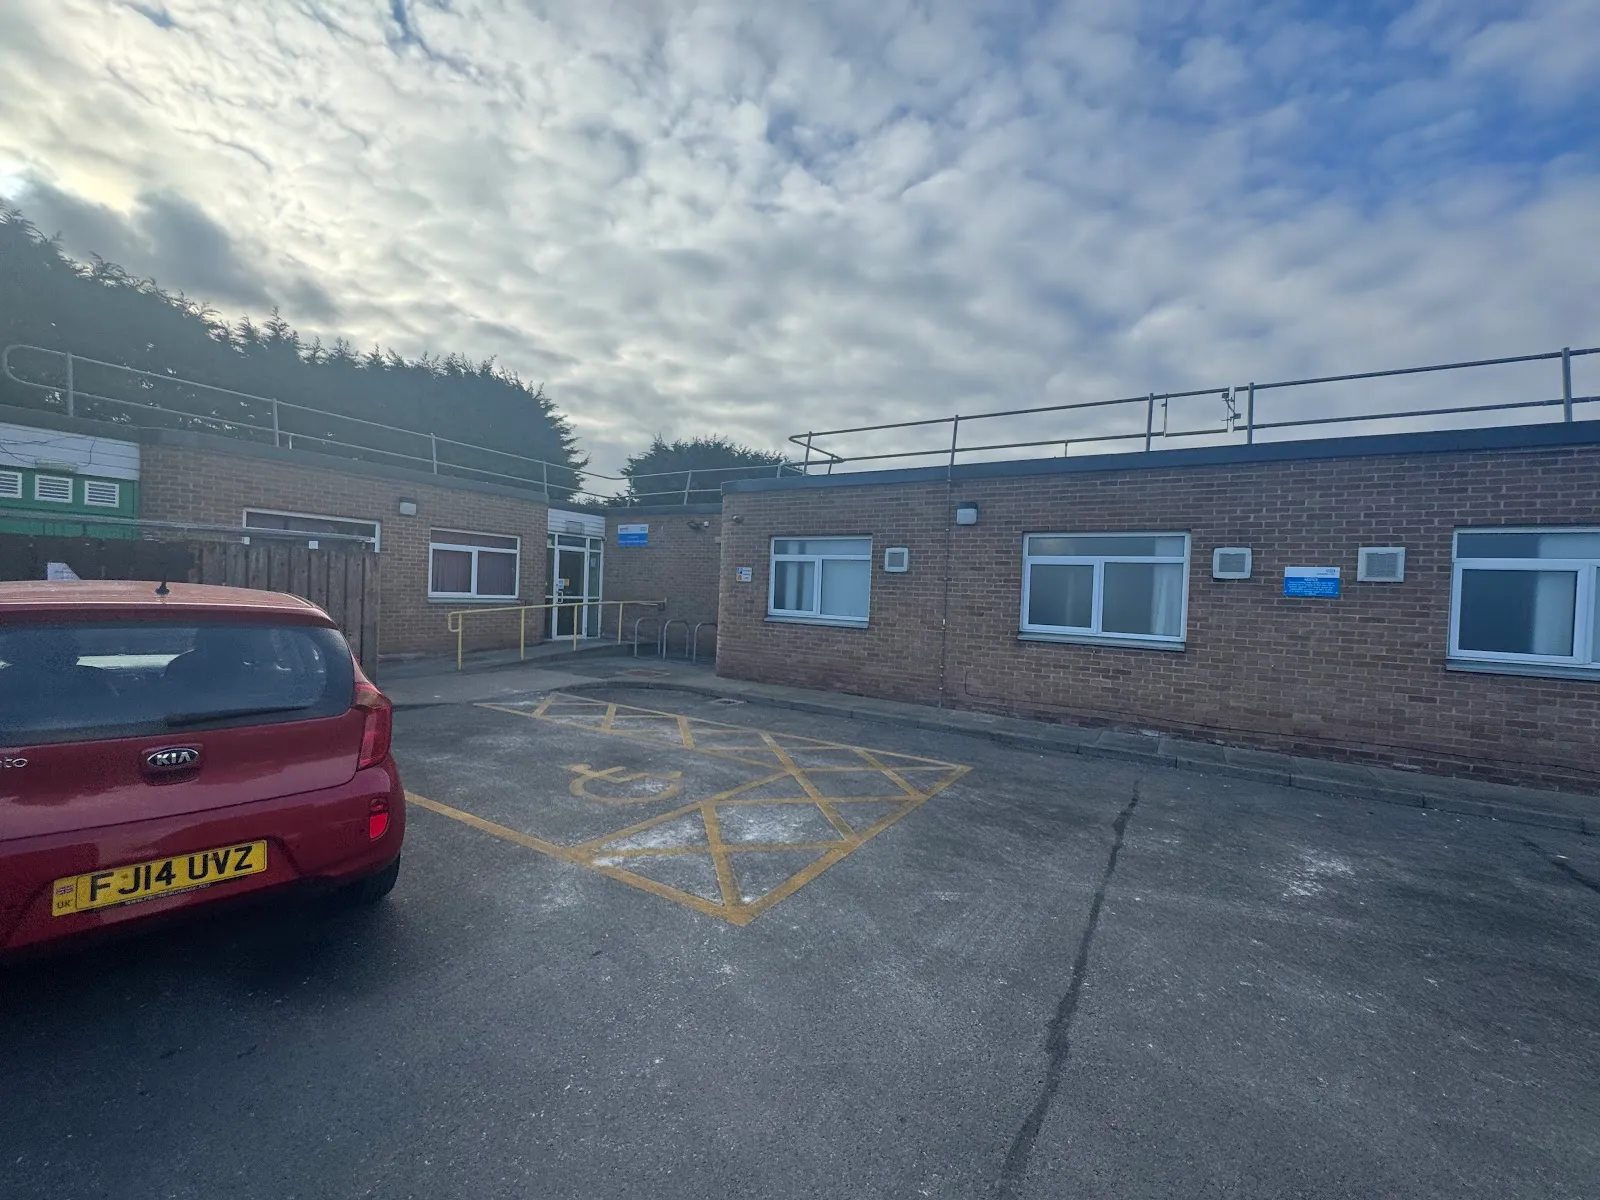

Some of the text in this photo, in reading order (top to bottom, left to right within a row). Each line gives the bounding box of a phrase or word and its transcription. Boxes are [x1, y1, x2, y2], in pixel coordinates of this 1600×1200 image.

[156, 751, 192, 766] KIA
[89, 861, 177, 902] FJ14
[187, 845, 254, 881] UVZ
[56, 899, 71, 909] UK
